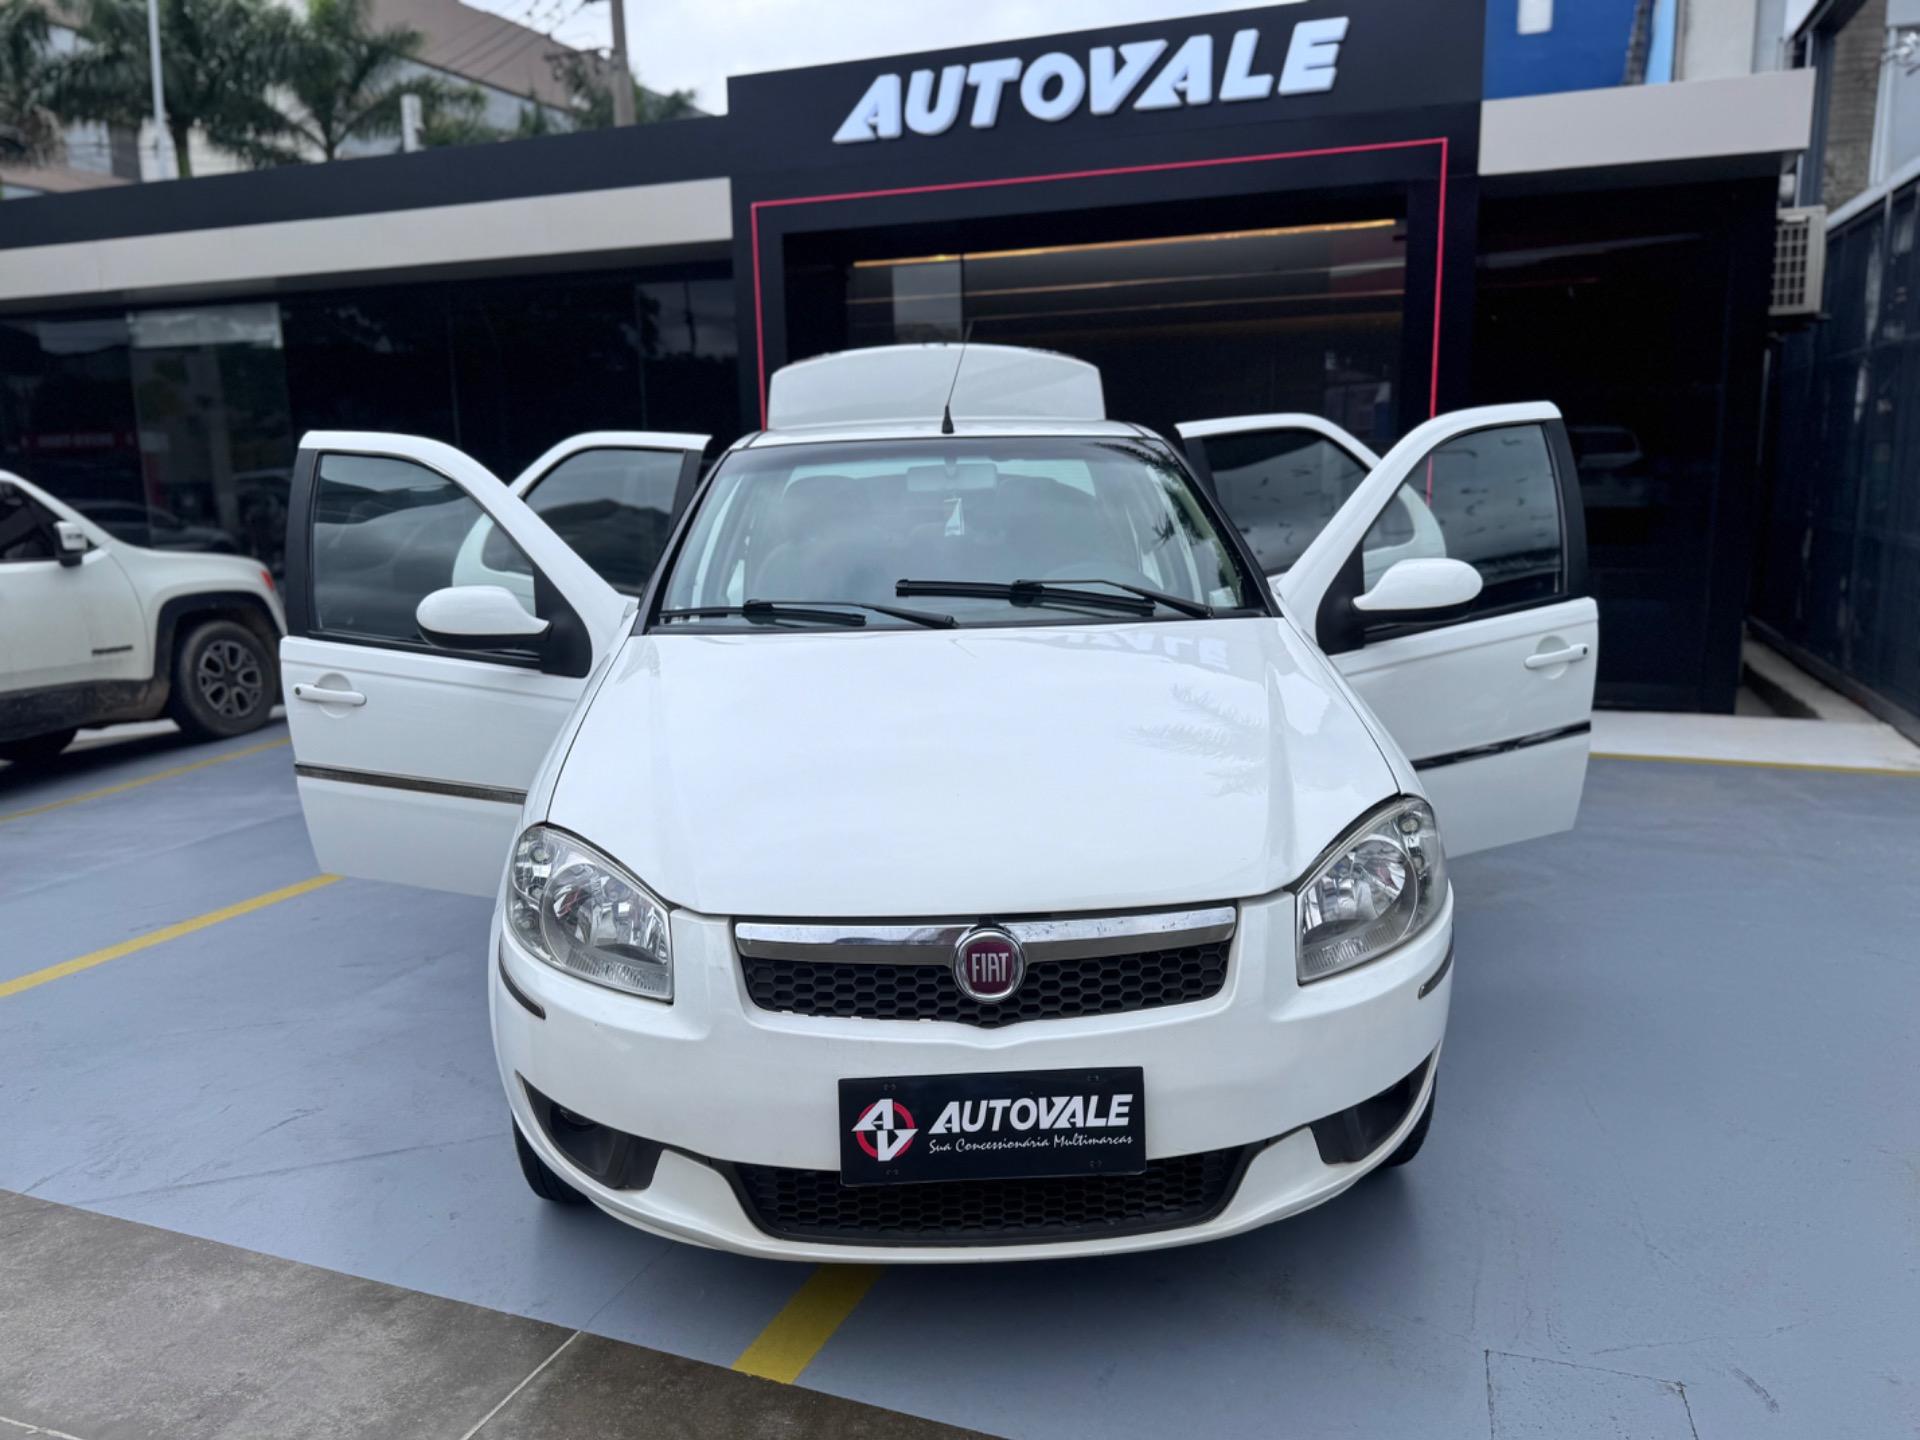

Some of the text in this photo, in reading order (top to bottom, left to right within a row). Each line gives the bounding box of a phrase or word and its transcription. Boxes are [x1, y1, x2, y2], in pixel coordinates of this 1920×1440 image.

[832, 16, 1349, 143] AUTOVALE
[971, 952, 1009, 983] FIAT
[928, 1094, 1133, 1134] AUTOVALE
[928, 1139, 952, 1154] Sua
[1053, 1132, 1133, 1149] Multimarcas
